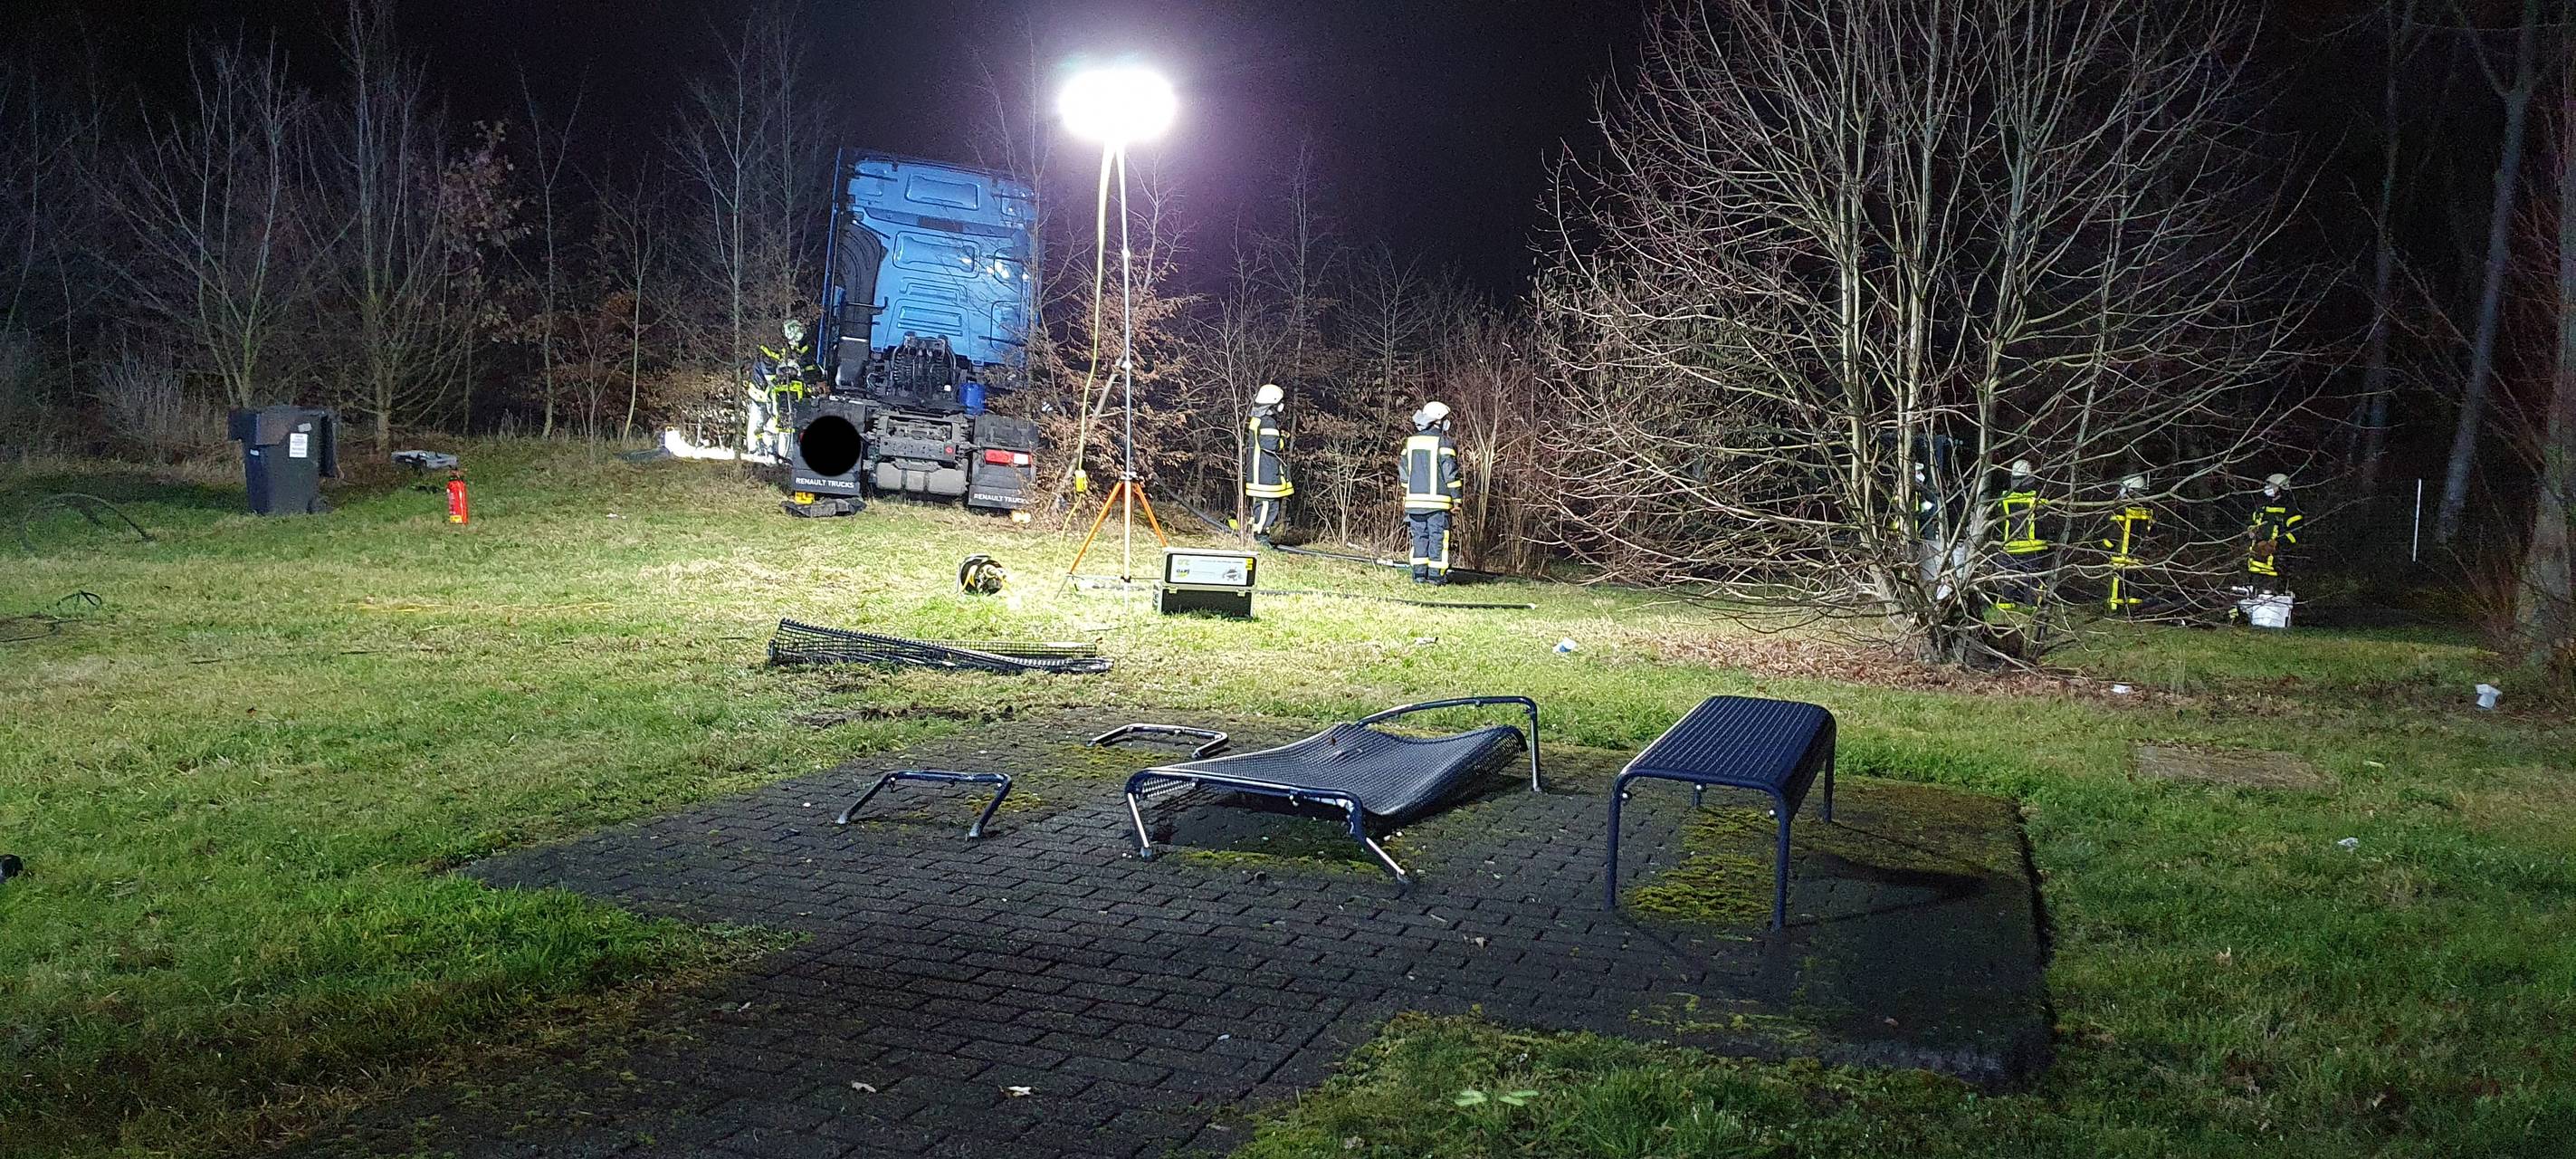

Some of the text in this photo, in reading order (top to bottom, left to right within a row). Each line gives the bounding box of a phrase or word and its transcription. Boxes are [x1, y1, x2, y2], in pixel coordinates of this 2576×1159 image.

[796, 477, 854, 488] RENAULT TRUCKS
[973, 493, 1030, 504] RENAULT TRUCK
